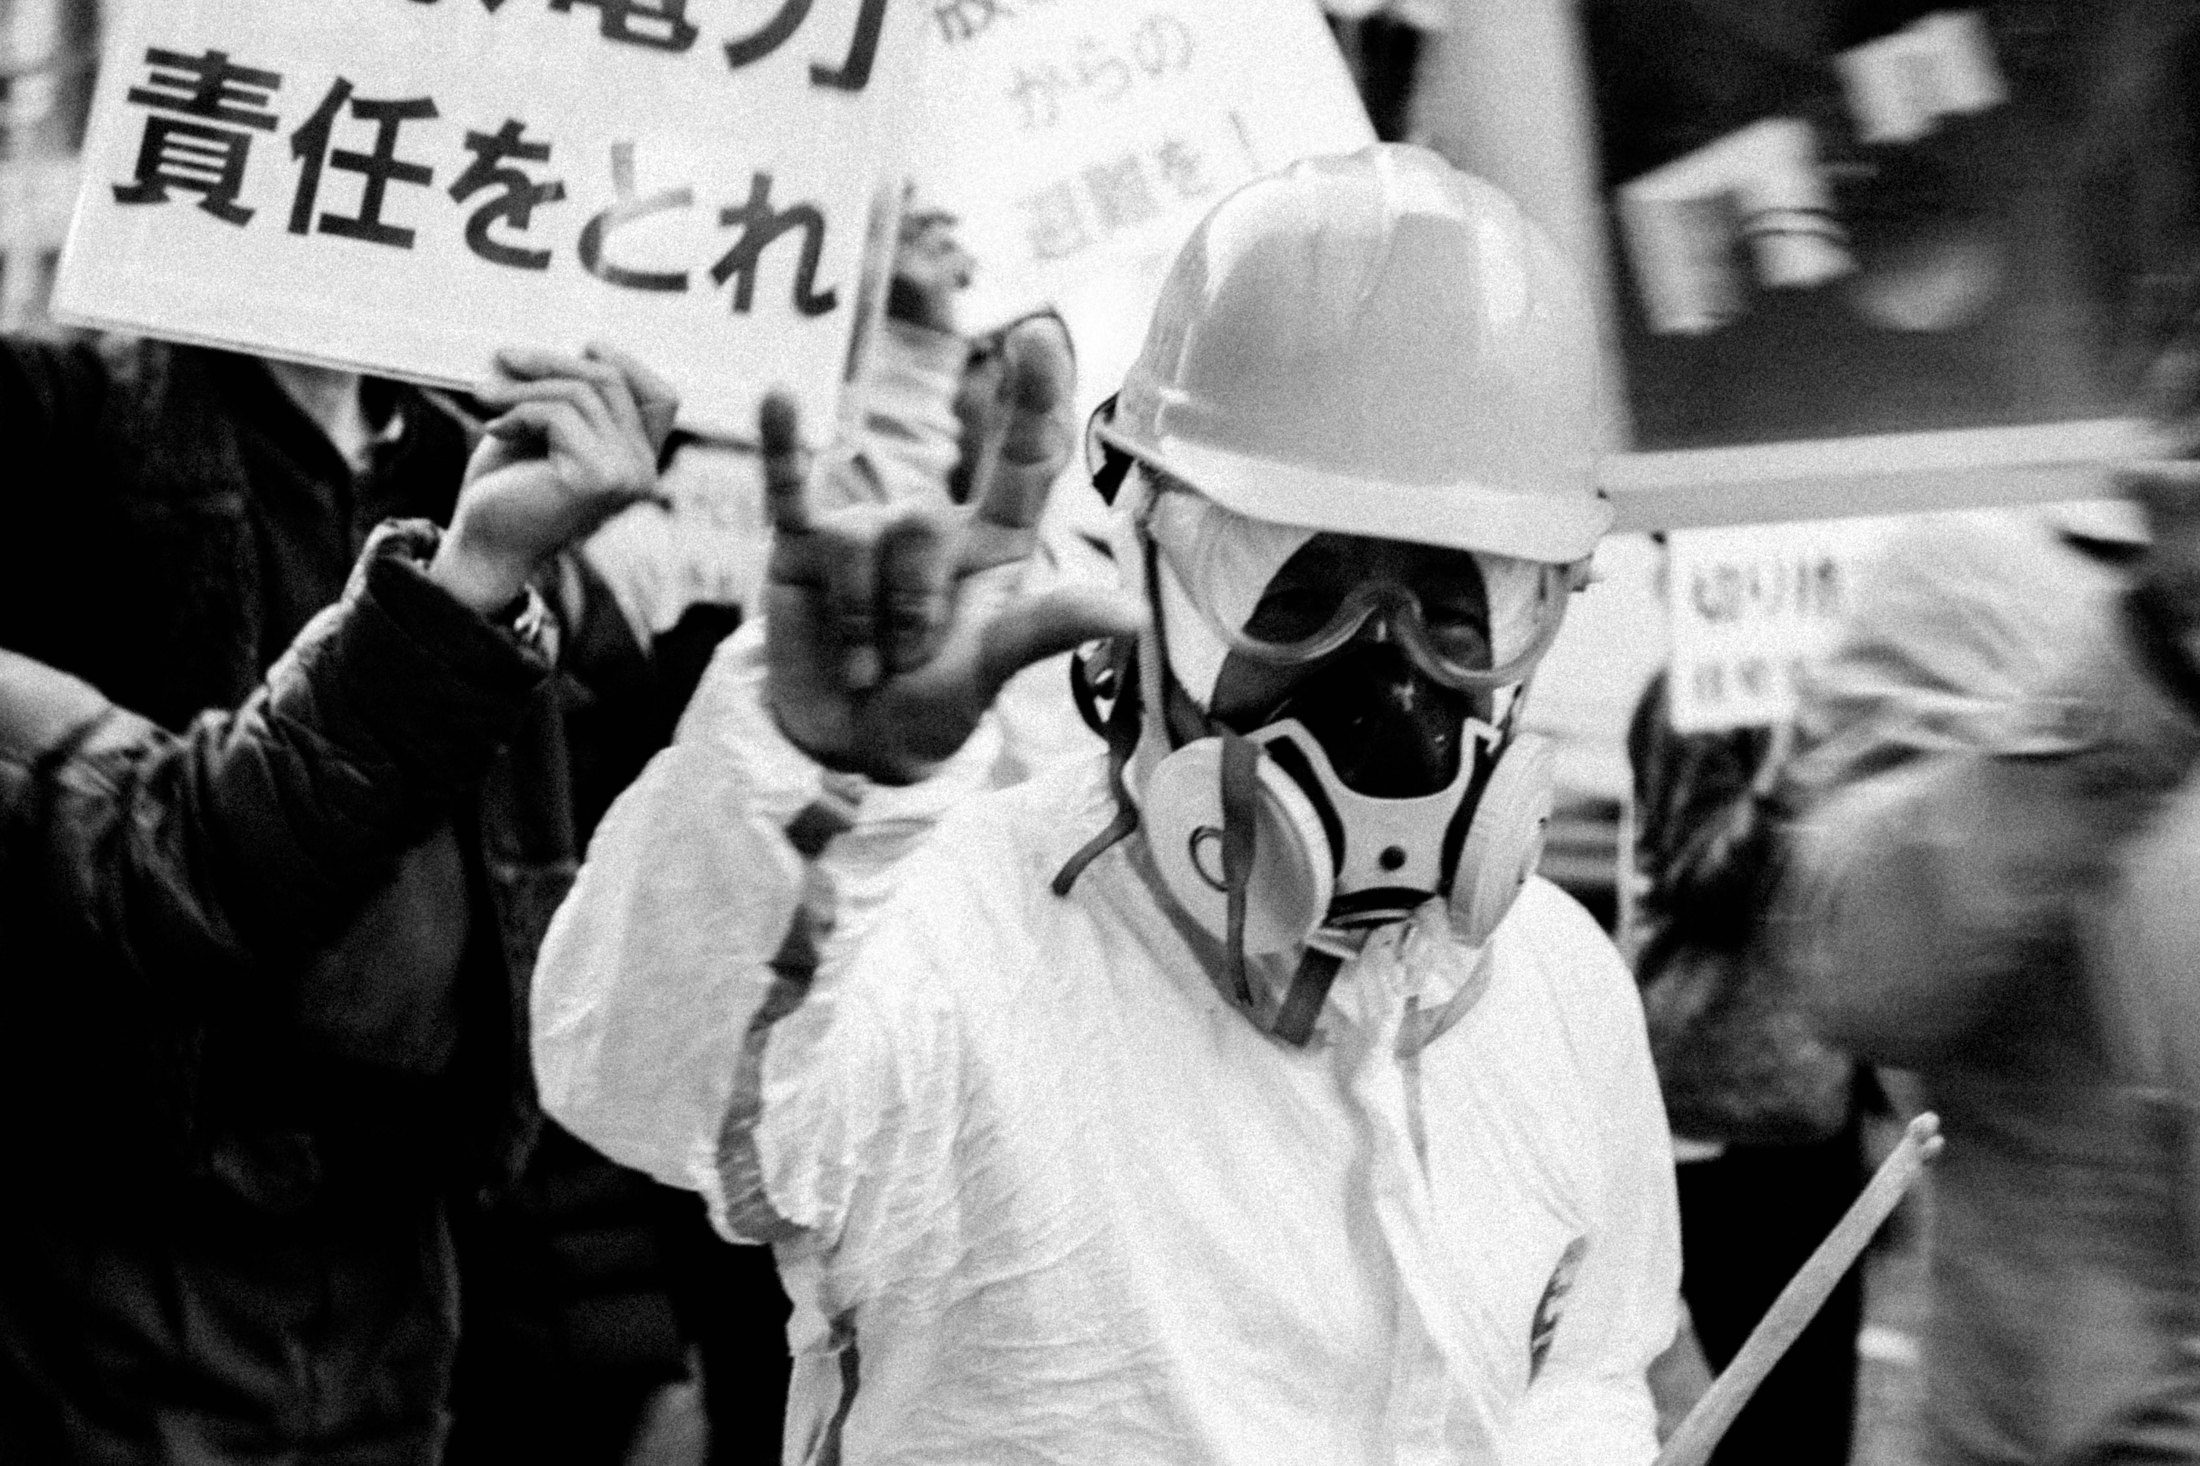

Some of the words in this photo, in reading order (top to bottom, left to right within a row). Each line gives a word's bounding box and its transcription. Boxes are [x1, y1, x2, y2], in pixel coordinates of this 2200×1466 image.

[111, 47, 839, 317] 責任をとれ
